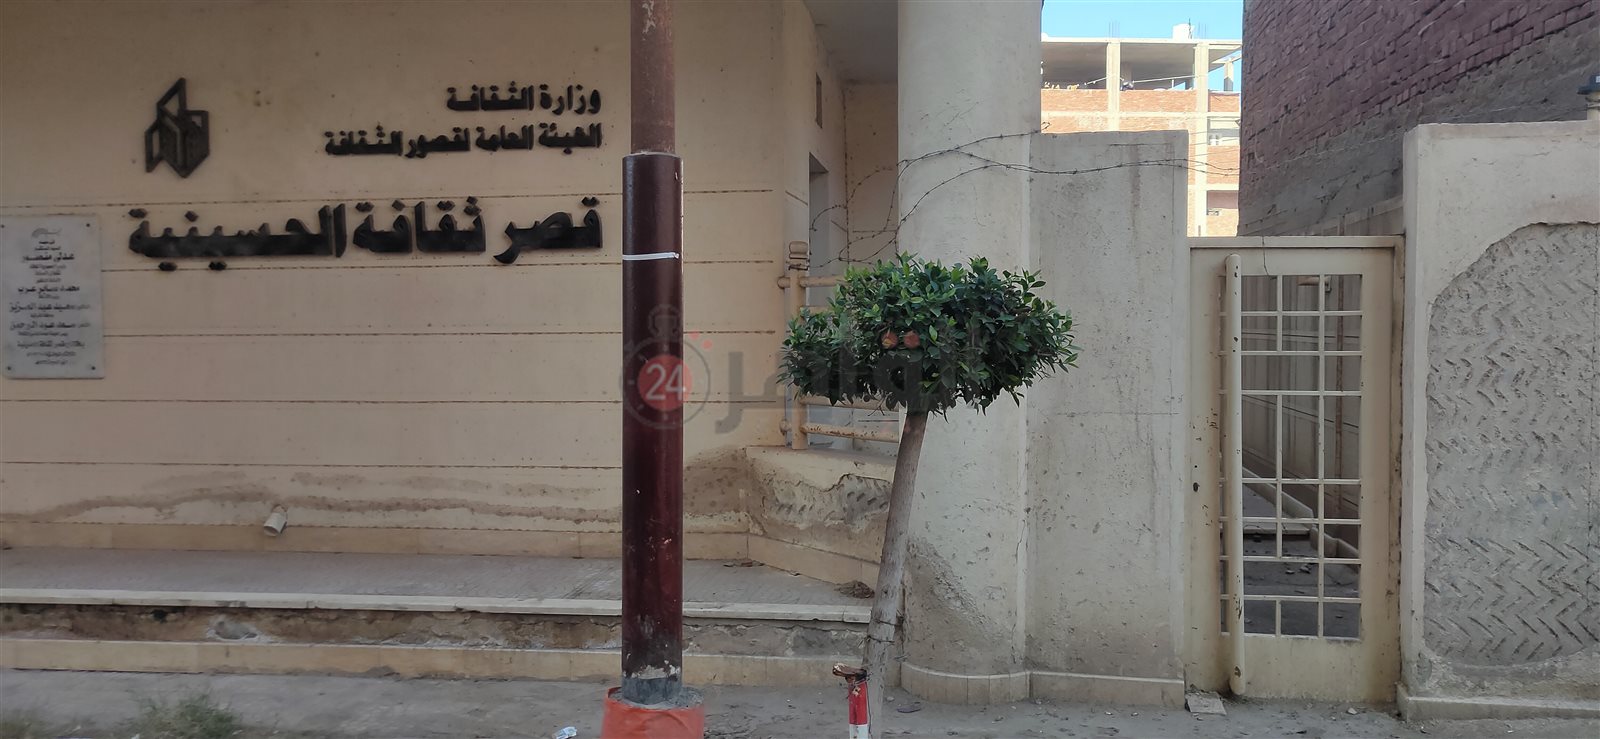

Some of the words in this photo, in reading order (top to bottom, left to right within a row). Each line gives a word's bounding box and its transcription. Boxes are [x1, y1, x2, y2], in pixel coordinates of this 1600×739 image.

[446, 80, 535, 113] الثقافة
[539, 83, 602, 116] وزارة
[323, 123, 404, 157] الثقافة
[403, 127, 471, 159] لقصور
[474, 124, 534, 153] العامة
[538, 122, 603, 155] الهيئة
[128, 203, 348, 272] الحسينية
[352, 195, 487, 256] ثقافة
[493, 196, 603, 266] قصر
